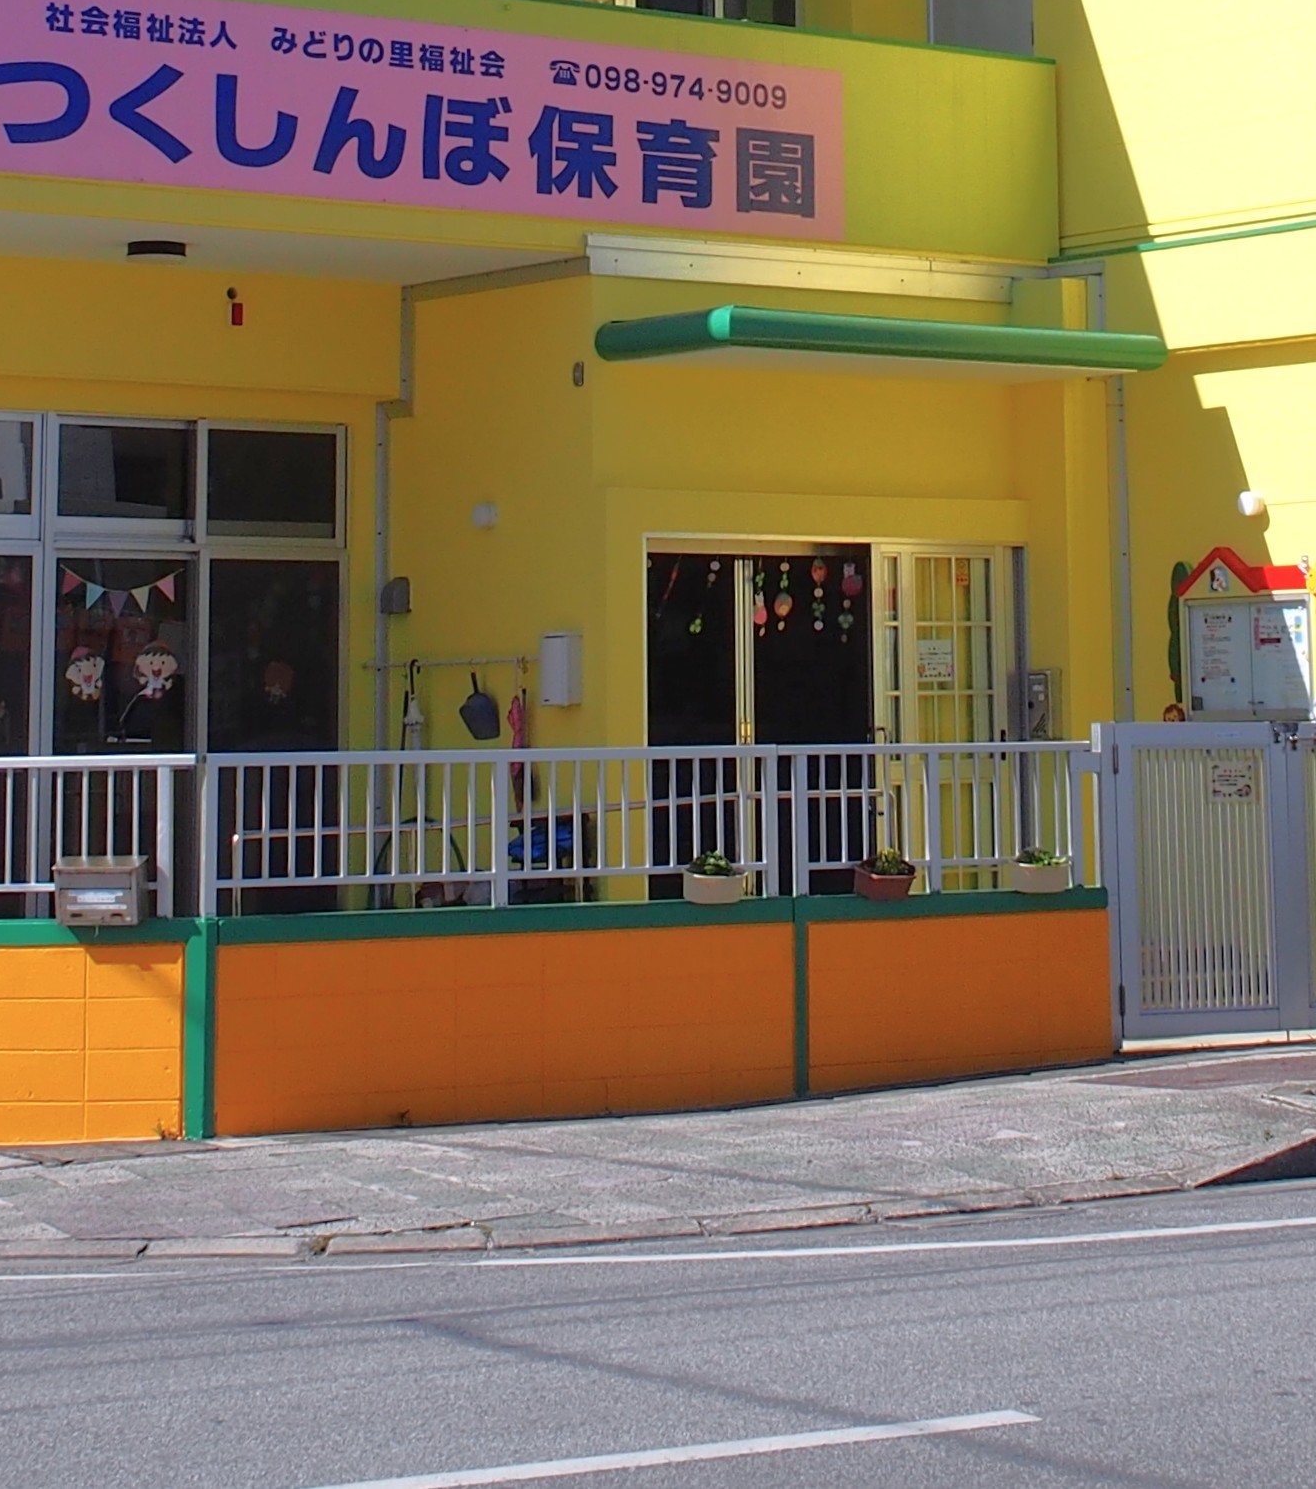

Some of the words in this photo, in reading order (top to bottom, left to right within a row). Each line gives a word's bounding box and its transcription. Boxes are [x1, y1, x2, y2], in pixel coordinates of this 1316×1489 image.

[45, 2, 237, 50] 社会福祉法人
[271, 27, 507, 79] みどりの里福祉会
